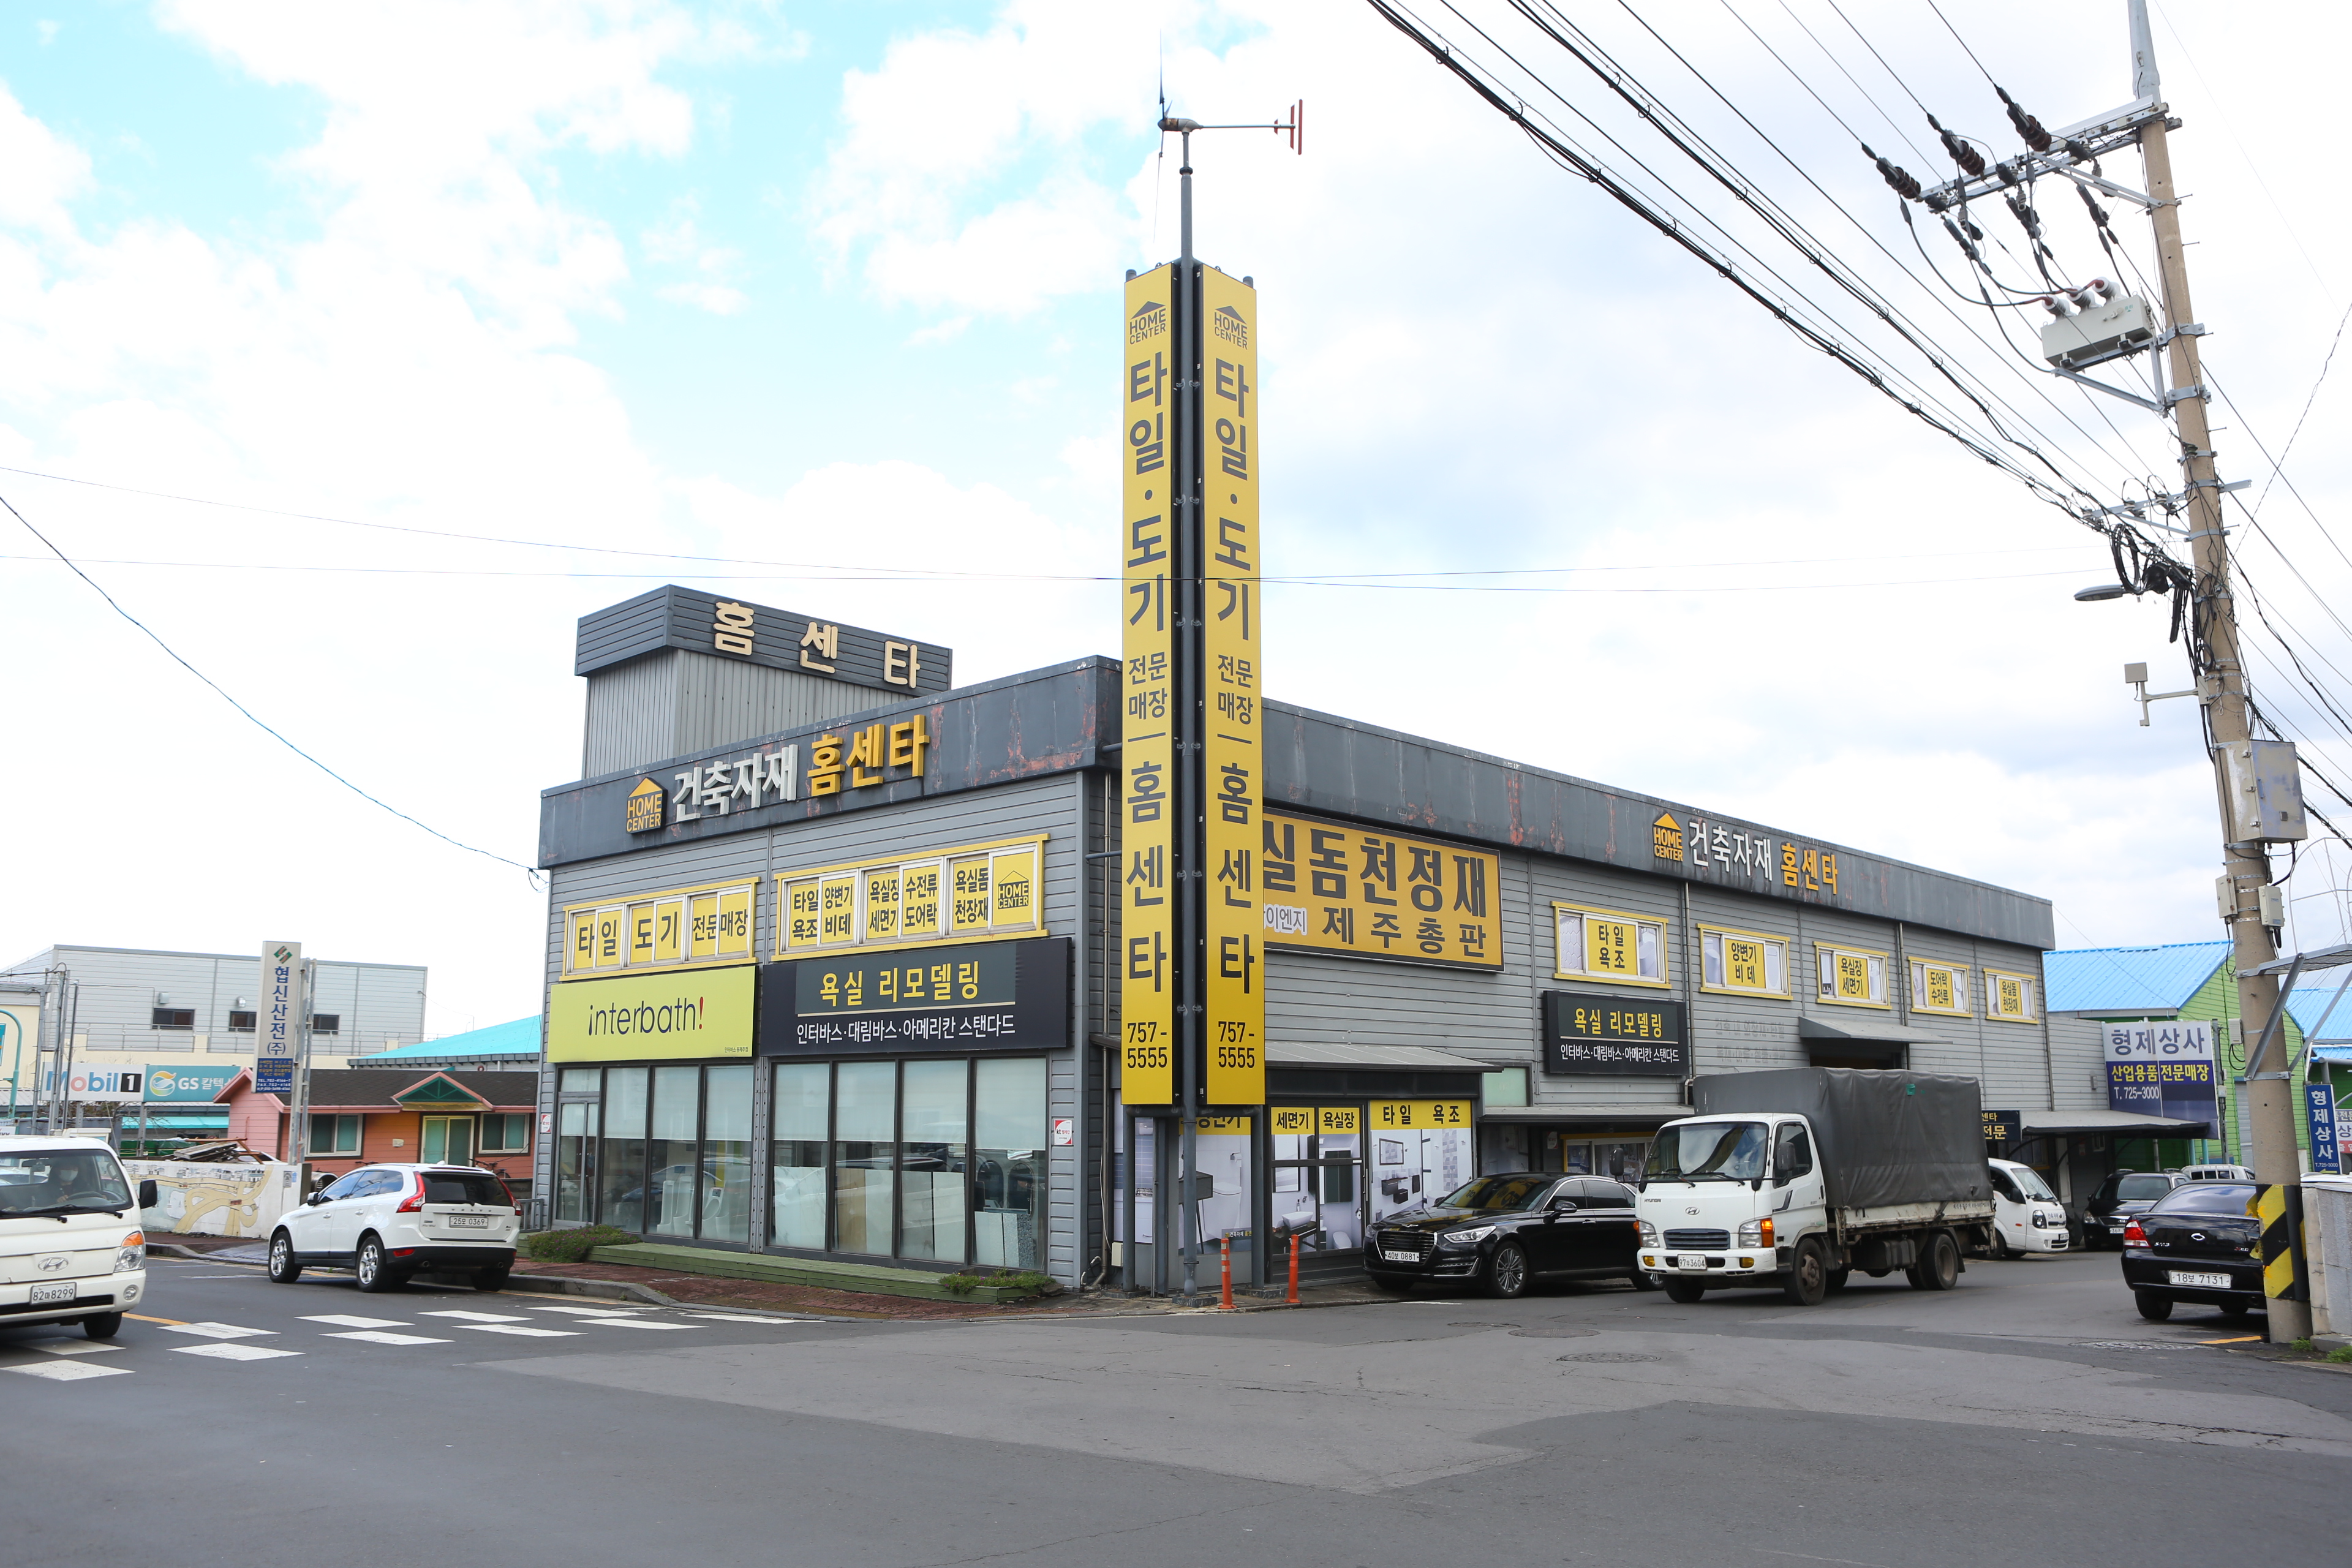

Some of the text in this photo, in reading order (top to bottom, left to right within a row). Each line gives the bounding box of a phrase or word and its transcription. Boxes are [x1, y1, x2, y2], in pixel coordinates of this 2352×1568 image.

[1129, 307, 1166, 335] HOME
[1214, 311, 1248, 339] HOME
[1129, 323, 1166, 345] CENTER
[1214, 326, 1248, 350] CENTER
[1128, 651, 1167, 685] 전문
[1218, 654, 1253, 688] 전문
[1128, 687, 1168, 720] 매장
[1218, 692, 1253, 725] 매장
[673, 714, 930, 823] 건축자재 홈센타
[627, 793, 662, 817] HOME
[626, 812, 662, 832] CENTER
[1654, 827, 1683, 849] HOME
[1654, 845, 1683, 862] CENTER
[1689, 821, 1838, 895] 건축자재 홈센타
[905, 873, 938, 900] 수전류
[956, 867, 989, 894] 욕실돔
[1126, 761, 1167, 993] 홈센타
[1217, 763, 1254, 994] 홈센타
[794, 889, 818, 913] 타일
[824, 883, 853, 910] 양변기
[870, 878, 899, 904] 욕실장
[998, 882, 1028, 899] HOME
[998, 895, 1028, 908] CENTER
[869, 908, 899, 932] 세면기
[905, 902, 937, 927] 도어락
[955, 896, 988, 924] 천장재
[1264, 906, 1306, 933] 이엔지
[578, 919, 617, 959] 타일
[635, 911, 678, 949] 도기
[793, 919, 818, 940] 욕조
[825, 913, 851, 937] 비데
[1598, 924, 1624, 947] 타일
[1599, 947, 1626, 969] 욕조
[1731, 942, 1757, 964] 양변기
[1735, 963, 1756, 984] 비데
[1841, 957, 1862, 977] 욕실장
[820, 960, 979, 1007] 욕실 리모델링
[1842, 977, 1863, 996] 세면기
[1930, 971, 1948, 988] 도어락
[1931, 987, 1949, 1005] 수전류
[2003, 997, 2018, 1012] 천장재
[588, 996, 704, 1036] interbath!
[959, 1014, 1016, 1037] 스탠다드
[1574, 1008, 1662, 1038] 욕실 리모델링
[1127, 1022, 1167, 1043] 757-
[1218, 1022, 1255, 1042] 757-
[2111, 1027, 2205, 1055] 형제상사
[1127, 1046, 1167, 1069] 5555
[1218, 1047, 1255, 1069] 5555
[1653, 1047, 1679, 1063] 스탠다드
[127, 1075, 135, 1091] 1
[178, 1077, 199, 1090] GS
[2111, 1064, 2209, 1082] 산업용품 전문매장
[2124, 1086, 2160, 1099] 725-3000
[1276, 1110, 1309, 1130] 세면기
[1322, 1110, 1355, 1129] 욕실장
[1383, 1104, 1461, 1125] 타일 욕조
[2311, 1090, 2334, 1159] 형제상사
[2176, 1273, 2223, 1285] 18보 7131
